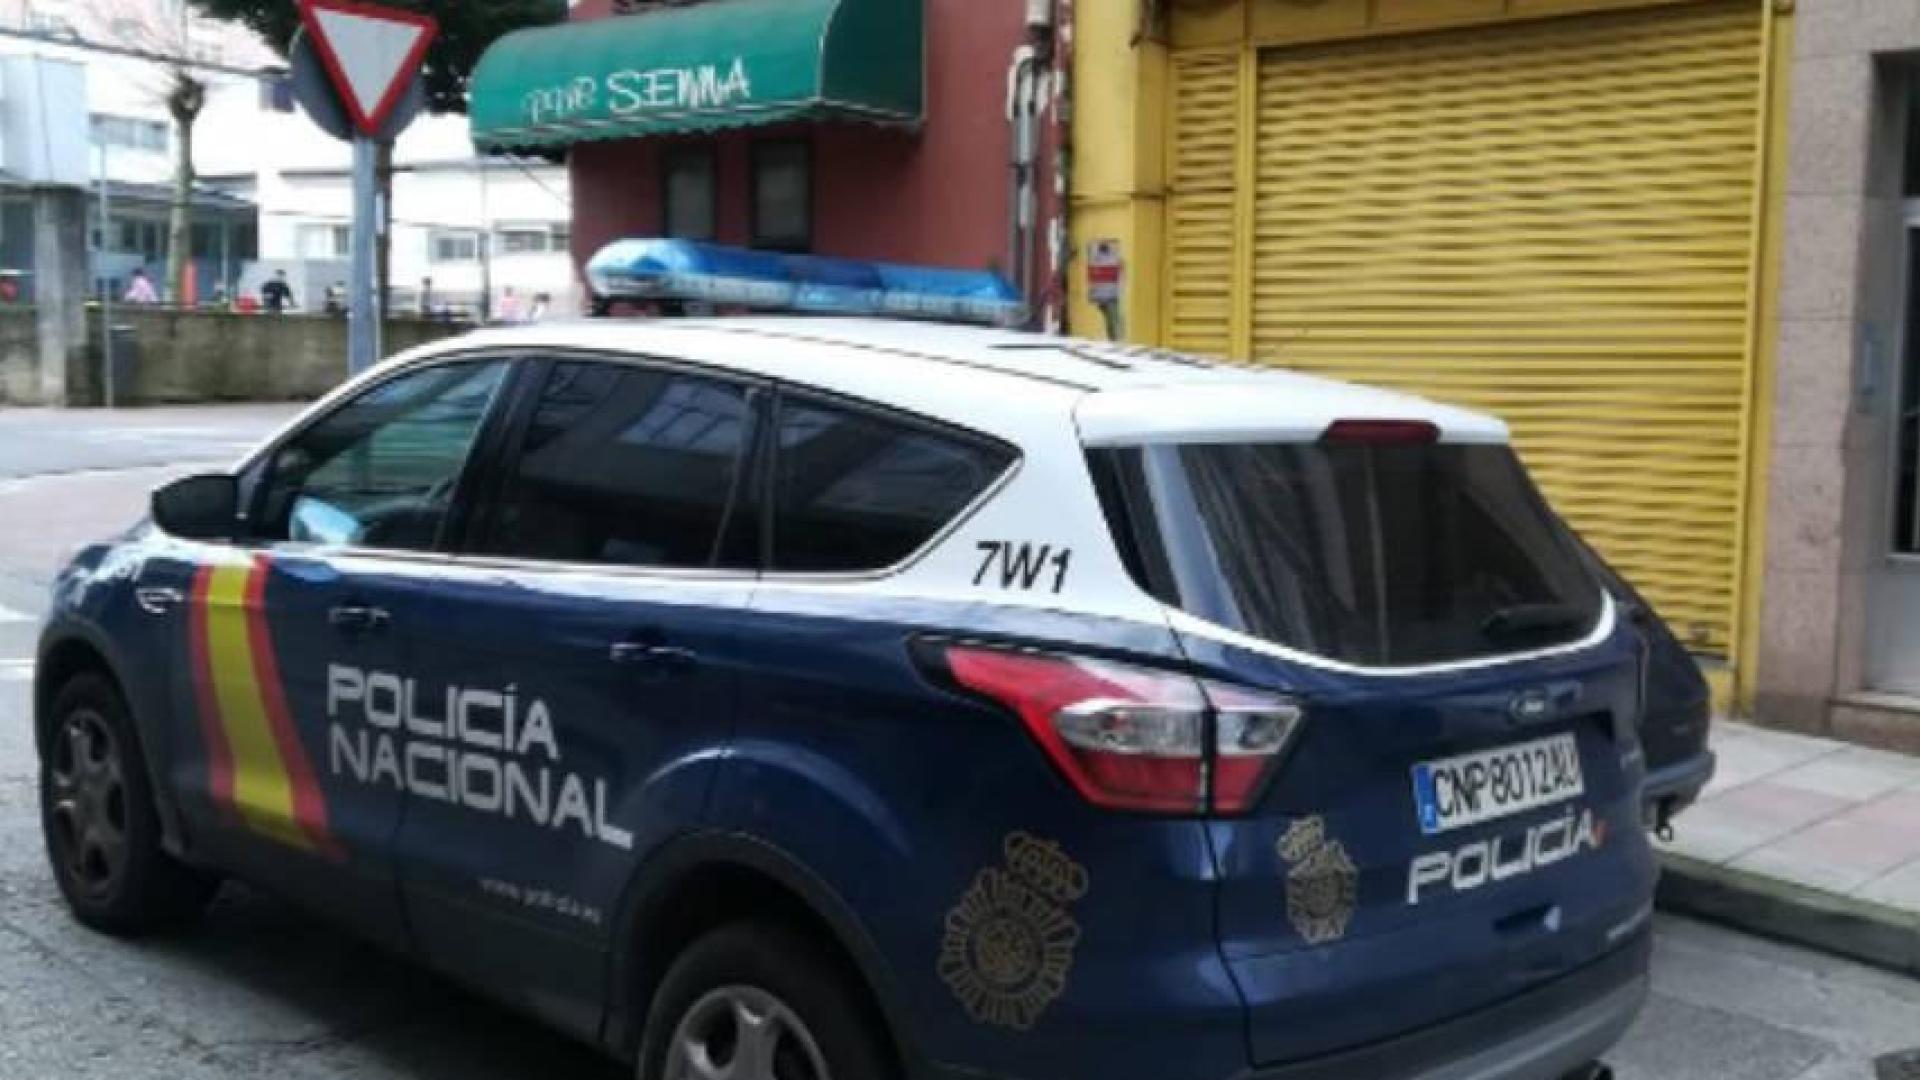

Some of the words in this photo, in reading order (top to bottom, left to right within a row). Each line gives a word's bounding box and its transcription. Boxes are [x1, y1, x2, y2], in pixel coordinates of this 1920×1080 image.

[972, 541, 1072, 594] 7W1
[327, 662, 560, 761] POLICÍA
[330, 722, 633, 850] NACIONAL
[1407, 804, 1599, 905] POLICÍA
